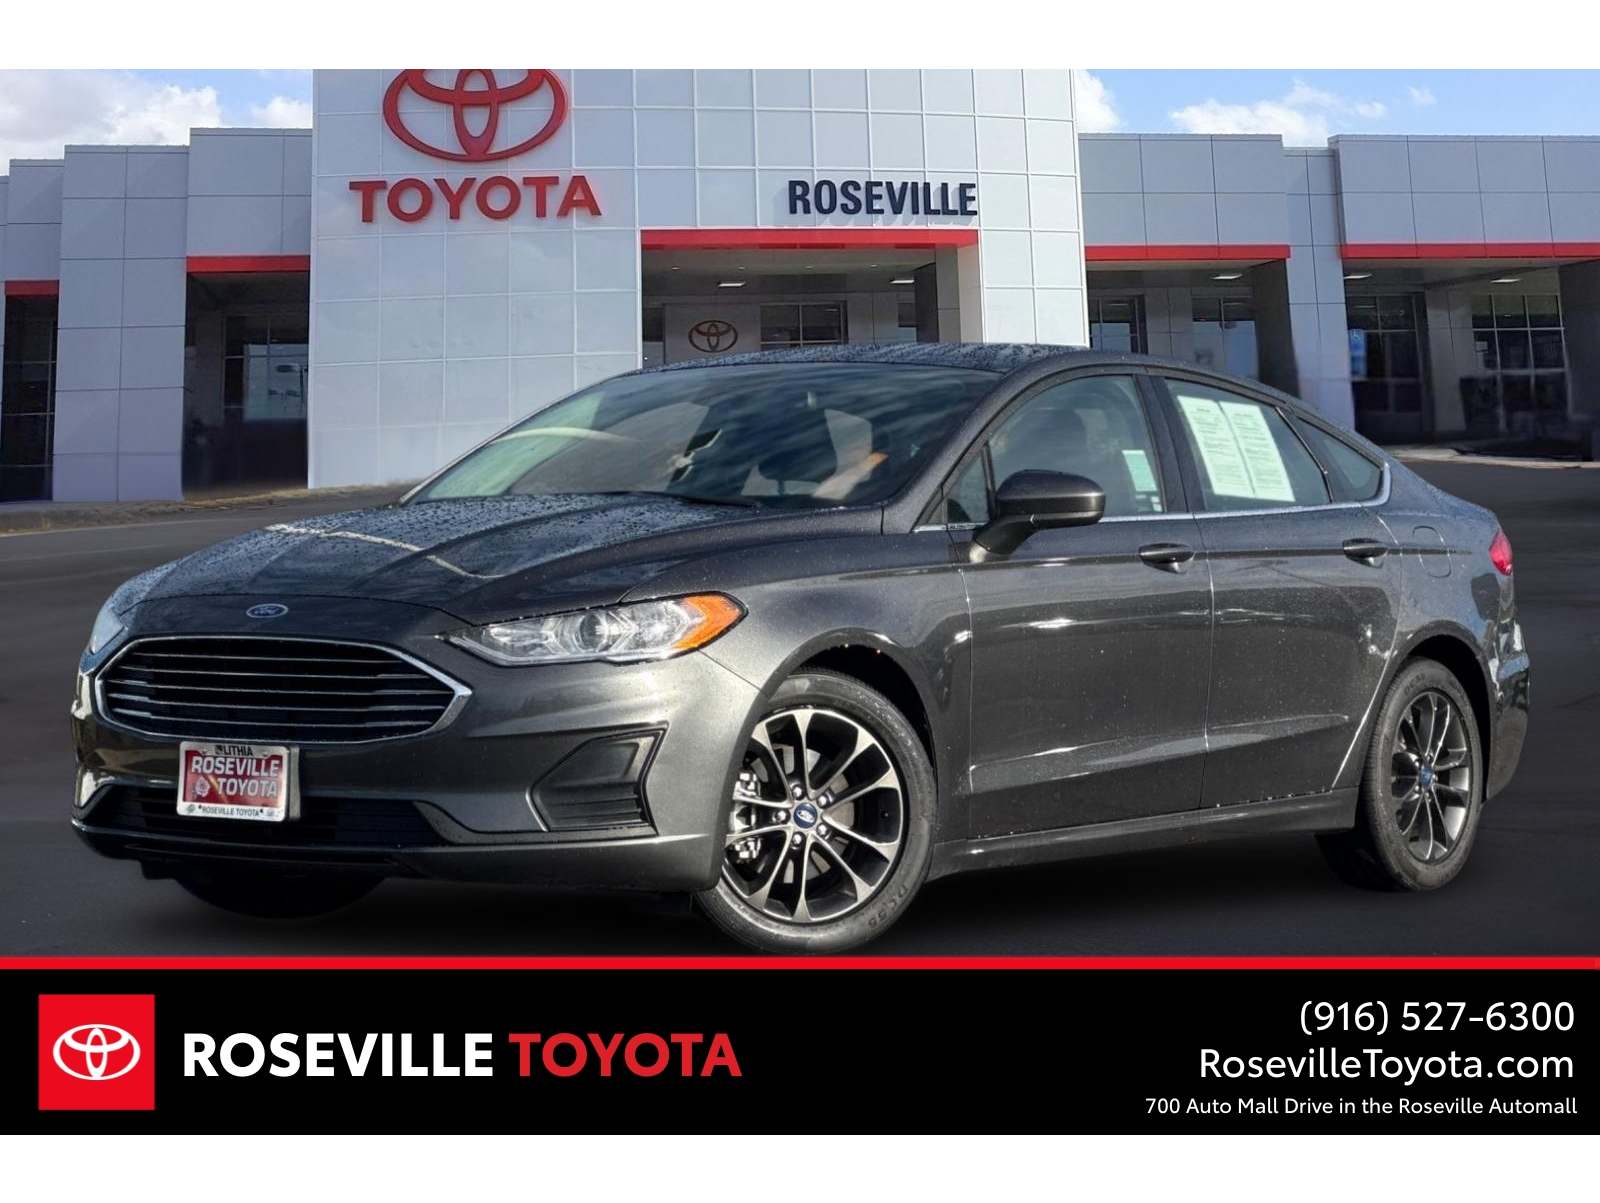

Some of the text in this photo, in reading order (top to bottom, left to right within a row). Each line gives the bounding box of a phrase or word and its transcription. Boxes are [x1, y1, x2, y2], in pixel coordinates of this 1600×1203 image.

[349, 175, 602, 222] TOYOTA
[788, 179, 979, 216] ROSEVILLE
[223, 745, 254, 756] LITHIA
[191, 756, 281, 777] ROSEVILLE
[217, 778, 277, 797] TOYOTA
